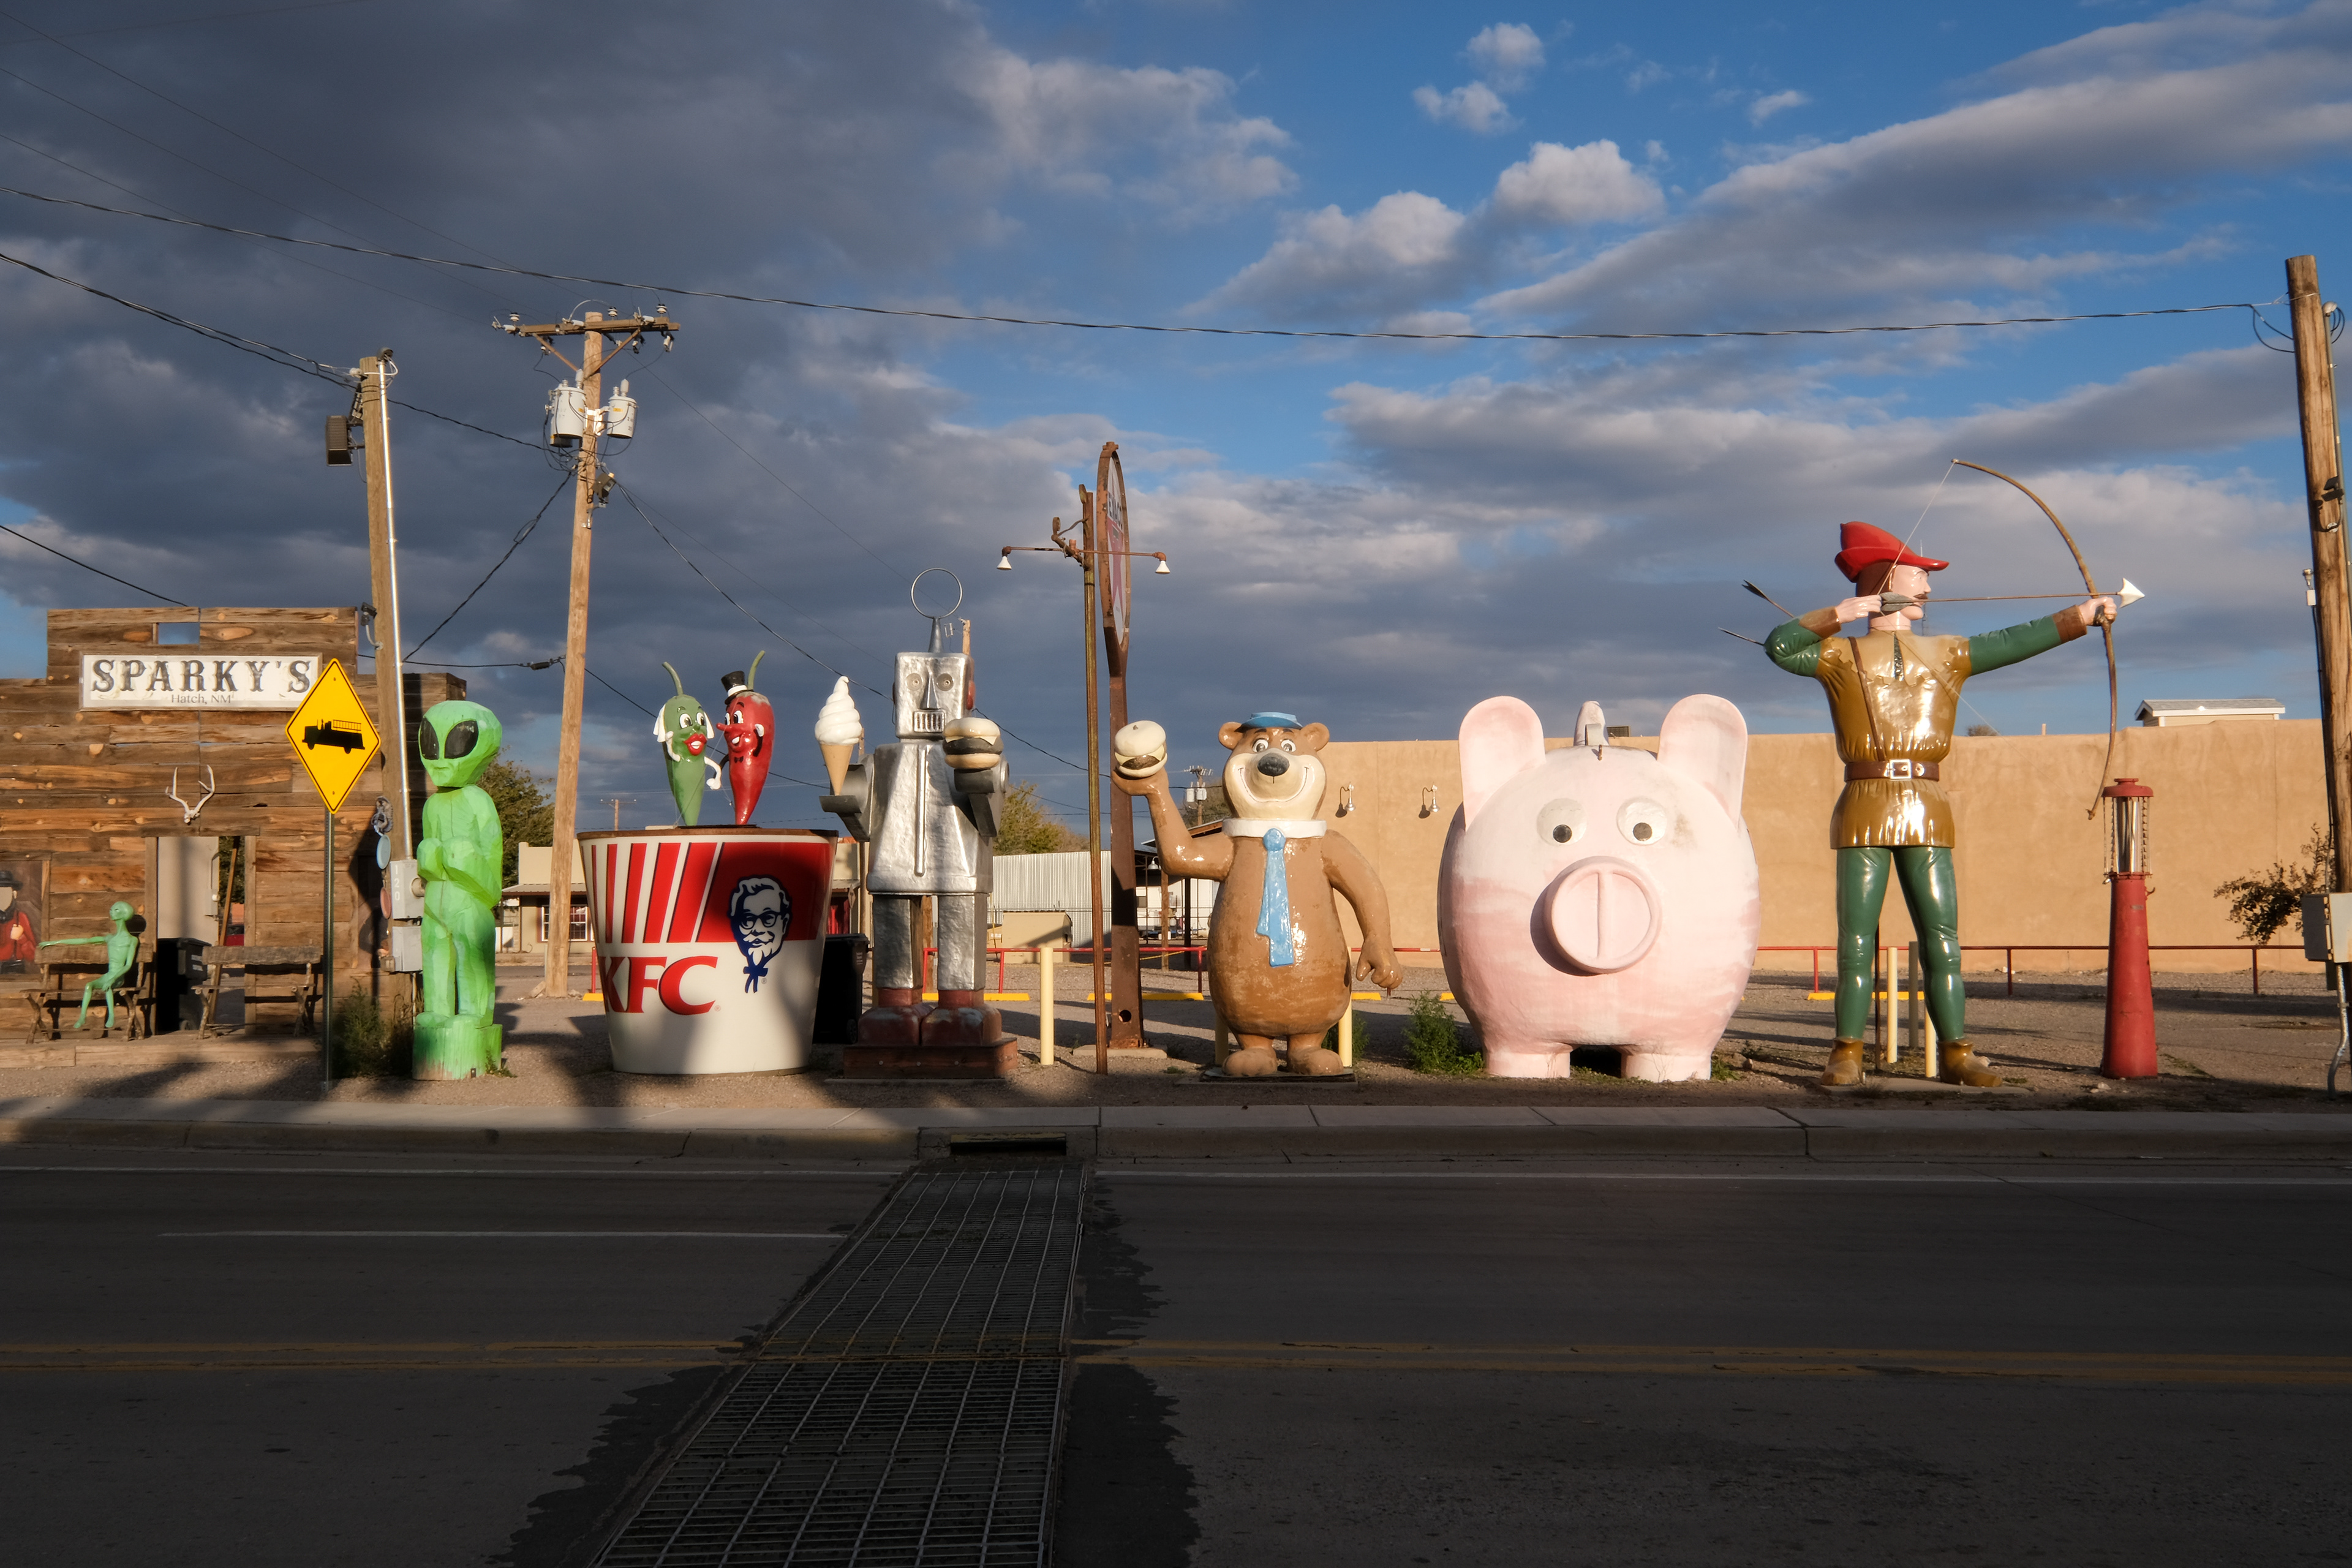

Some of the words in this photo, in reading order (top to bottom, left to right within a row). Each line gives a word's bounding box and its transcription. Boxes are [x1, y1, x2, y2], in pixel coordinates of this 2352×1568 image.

[92, 660, 311, 693] SPARKY'S
[172, 694, 207, 704] Hatch,
[211, 695, 232, 704] NM
[598, 956, 718, 1016] KFC
